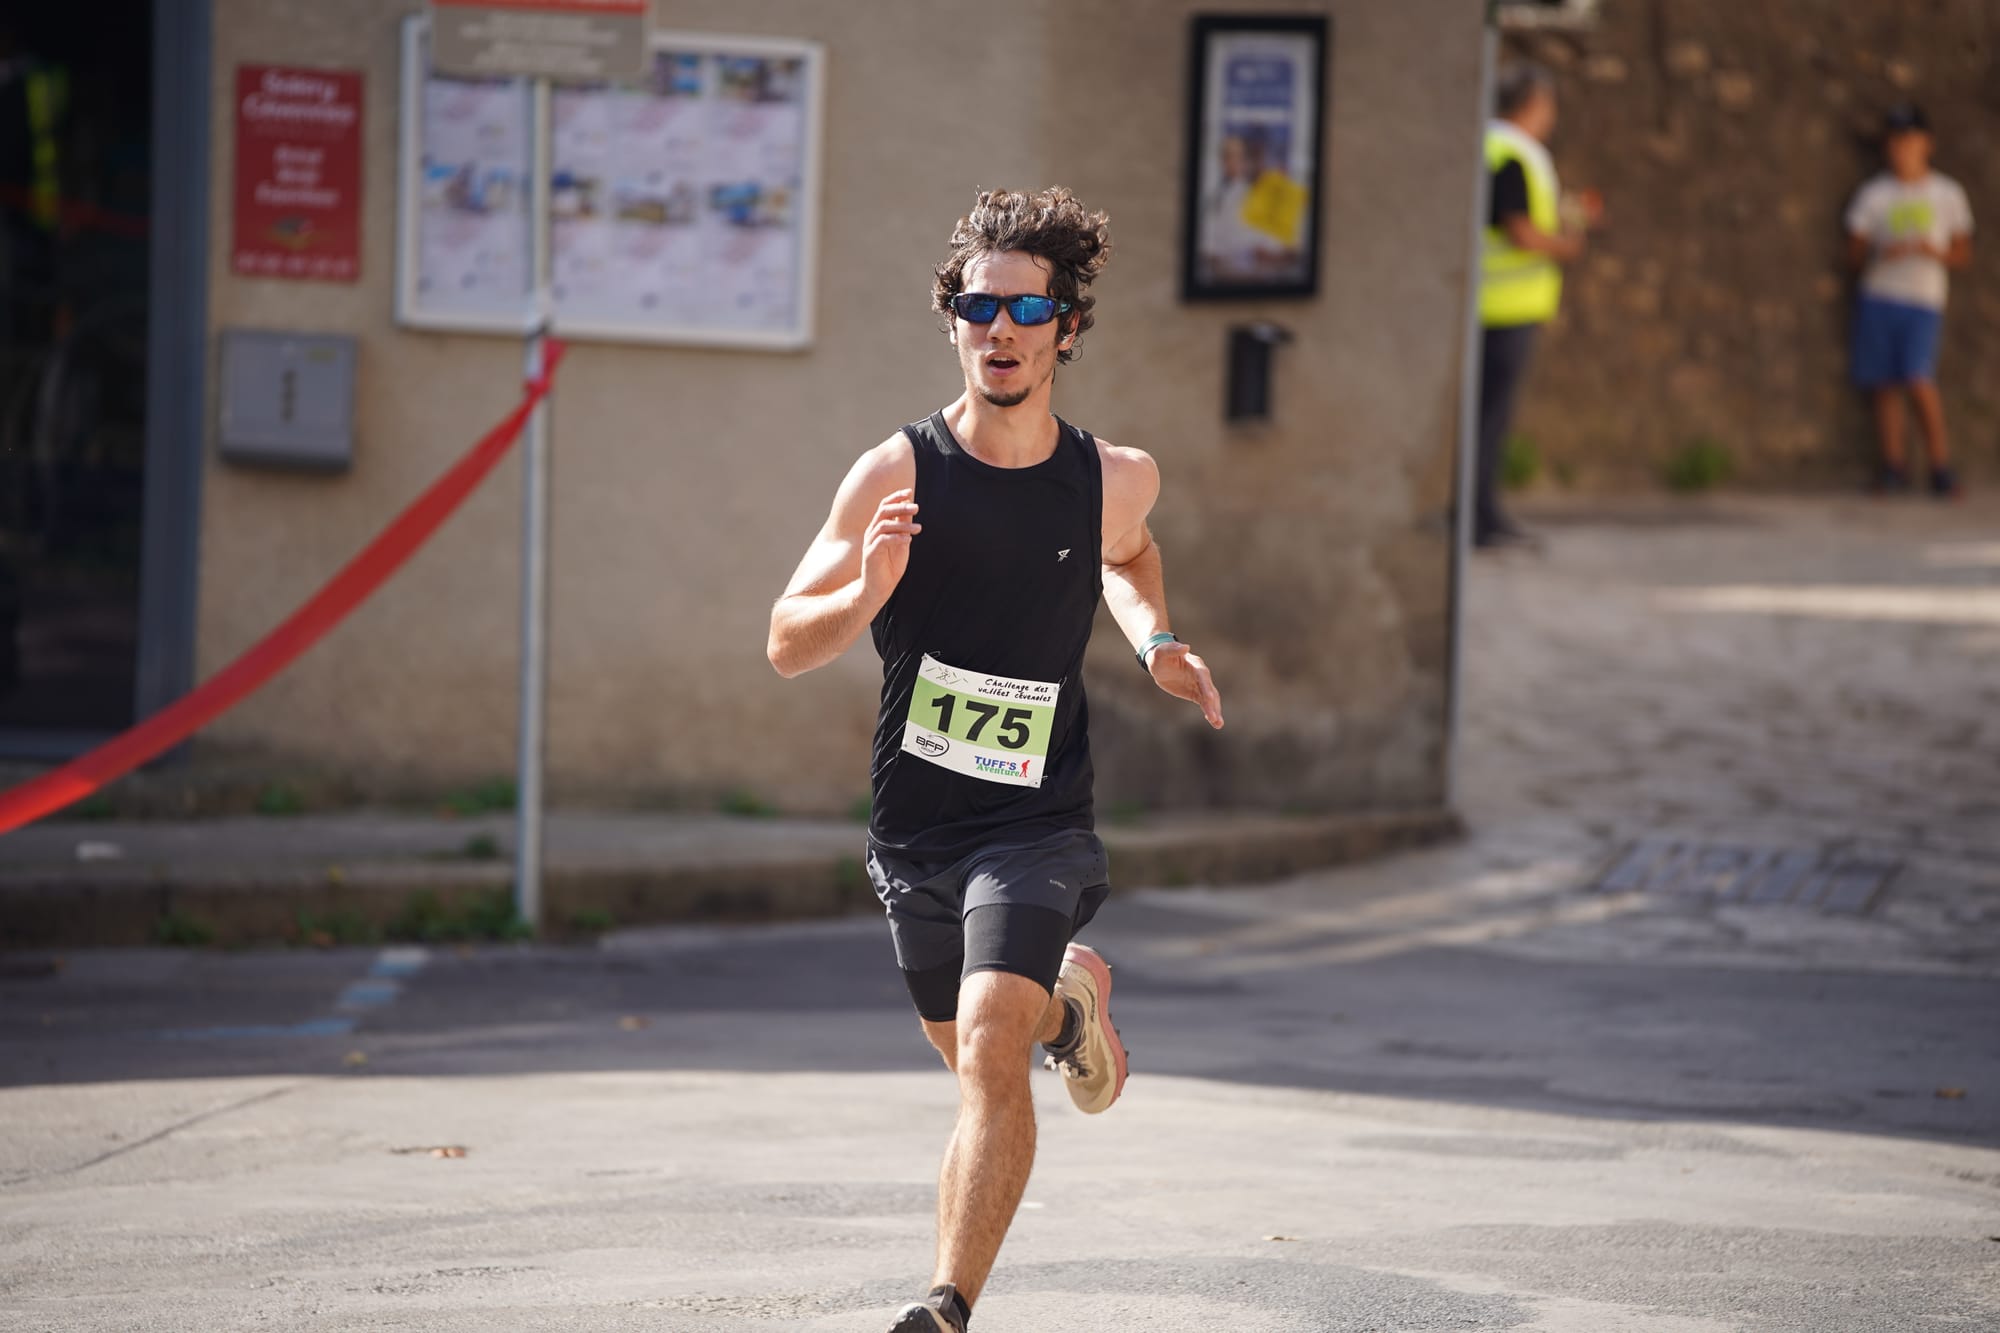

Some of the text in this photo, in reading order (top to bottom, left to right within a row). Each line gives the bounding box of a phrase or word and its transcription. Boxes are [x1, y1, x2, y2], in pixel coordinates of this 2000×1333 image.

[985, 679, 1049, 693] Challenge des
[931, 693, 1033, 749] 175
[916, 735, 944, 751] BFP
[974, 755, 1017, 771] TUFF'S
[976, 763, 1020, 778] Aventure
